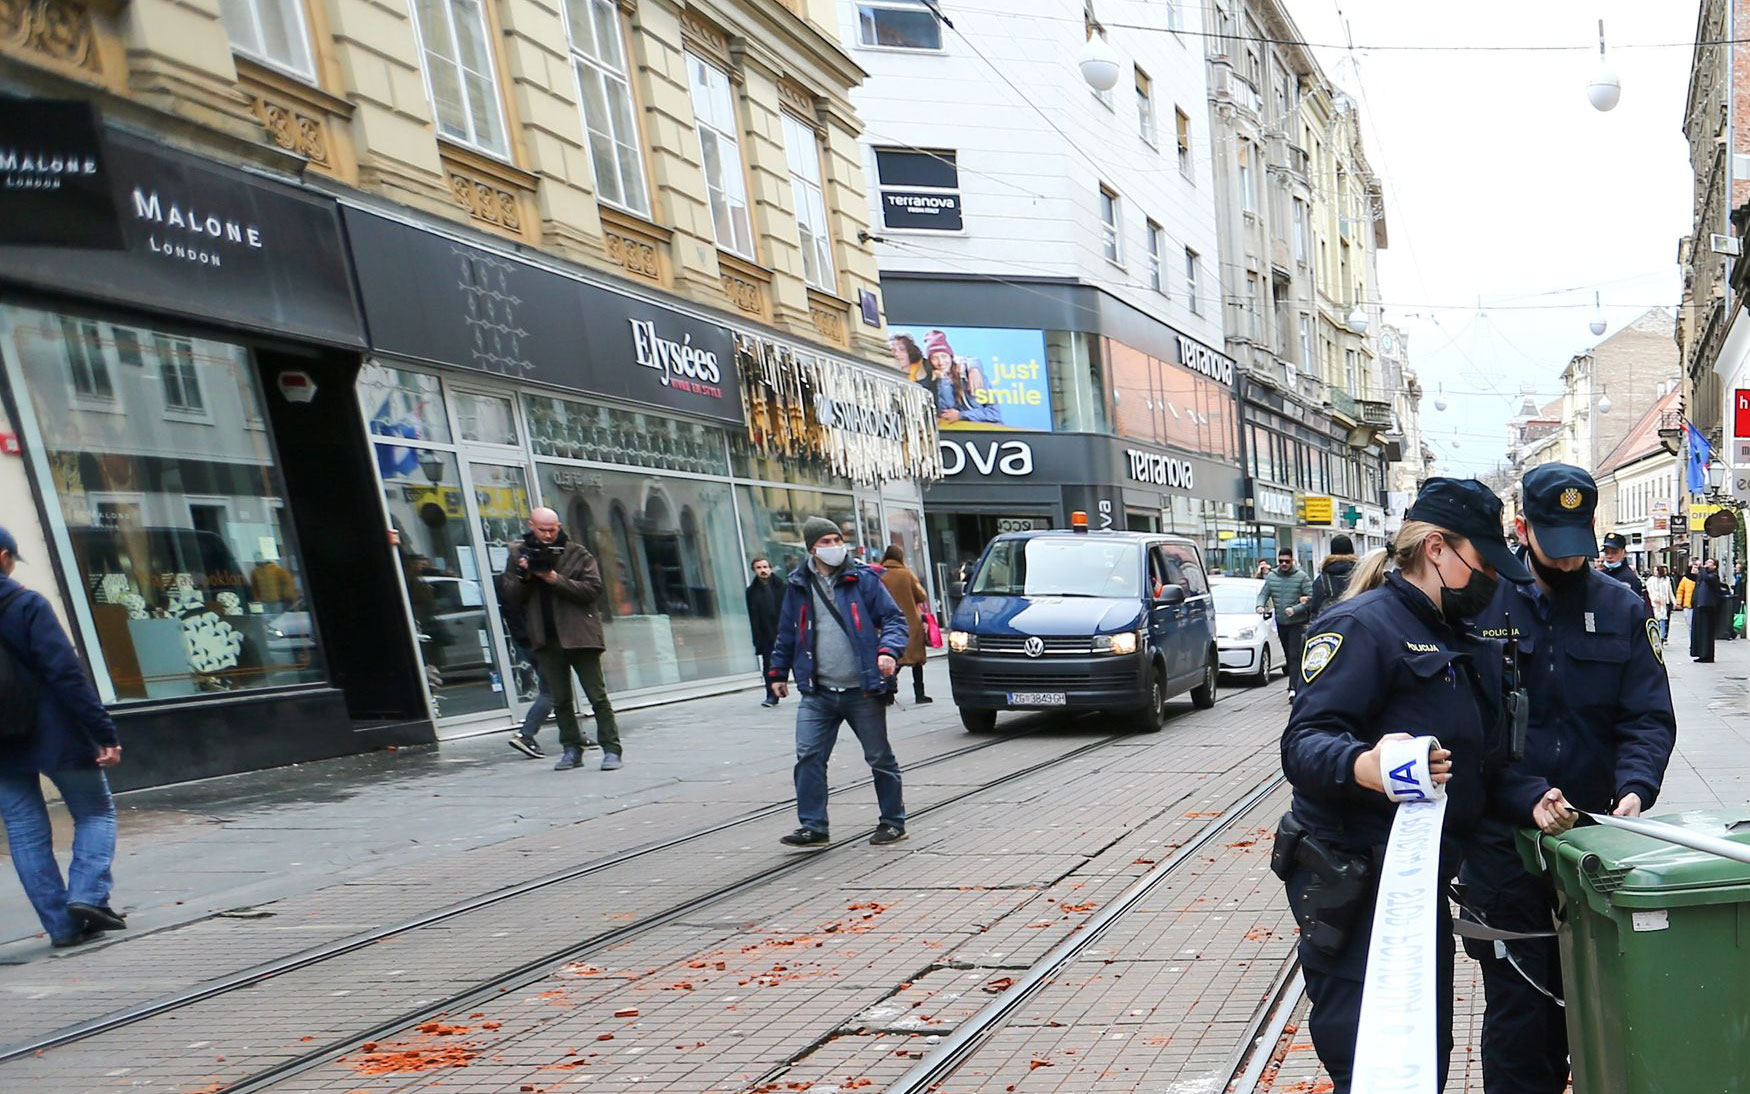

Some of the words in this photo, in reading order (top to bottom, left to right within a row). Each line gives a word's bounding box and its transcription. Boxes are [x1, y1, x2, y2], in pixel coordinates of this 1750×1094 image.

[132, 186, 263, 249] MALONE
[149, 235, 222, 267] LONDON
[628, 317, 722, 387] Elysées
[990, 356, 1039, 385] just
[1177, 334, 1235, 387] Terranova
[974, 383, 1041, 406] smile
[833, 400, 903, 442] SWAROVSKI
[1126, 449, 1194, 490] Terranova
